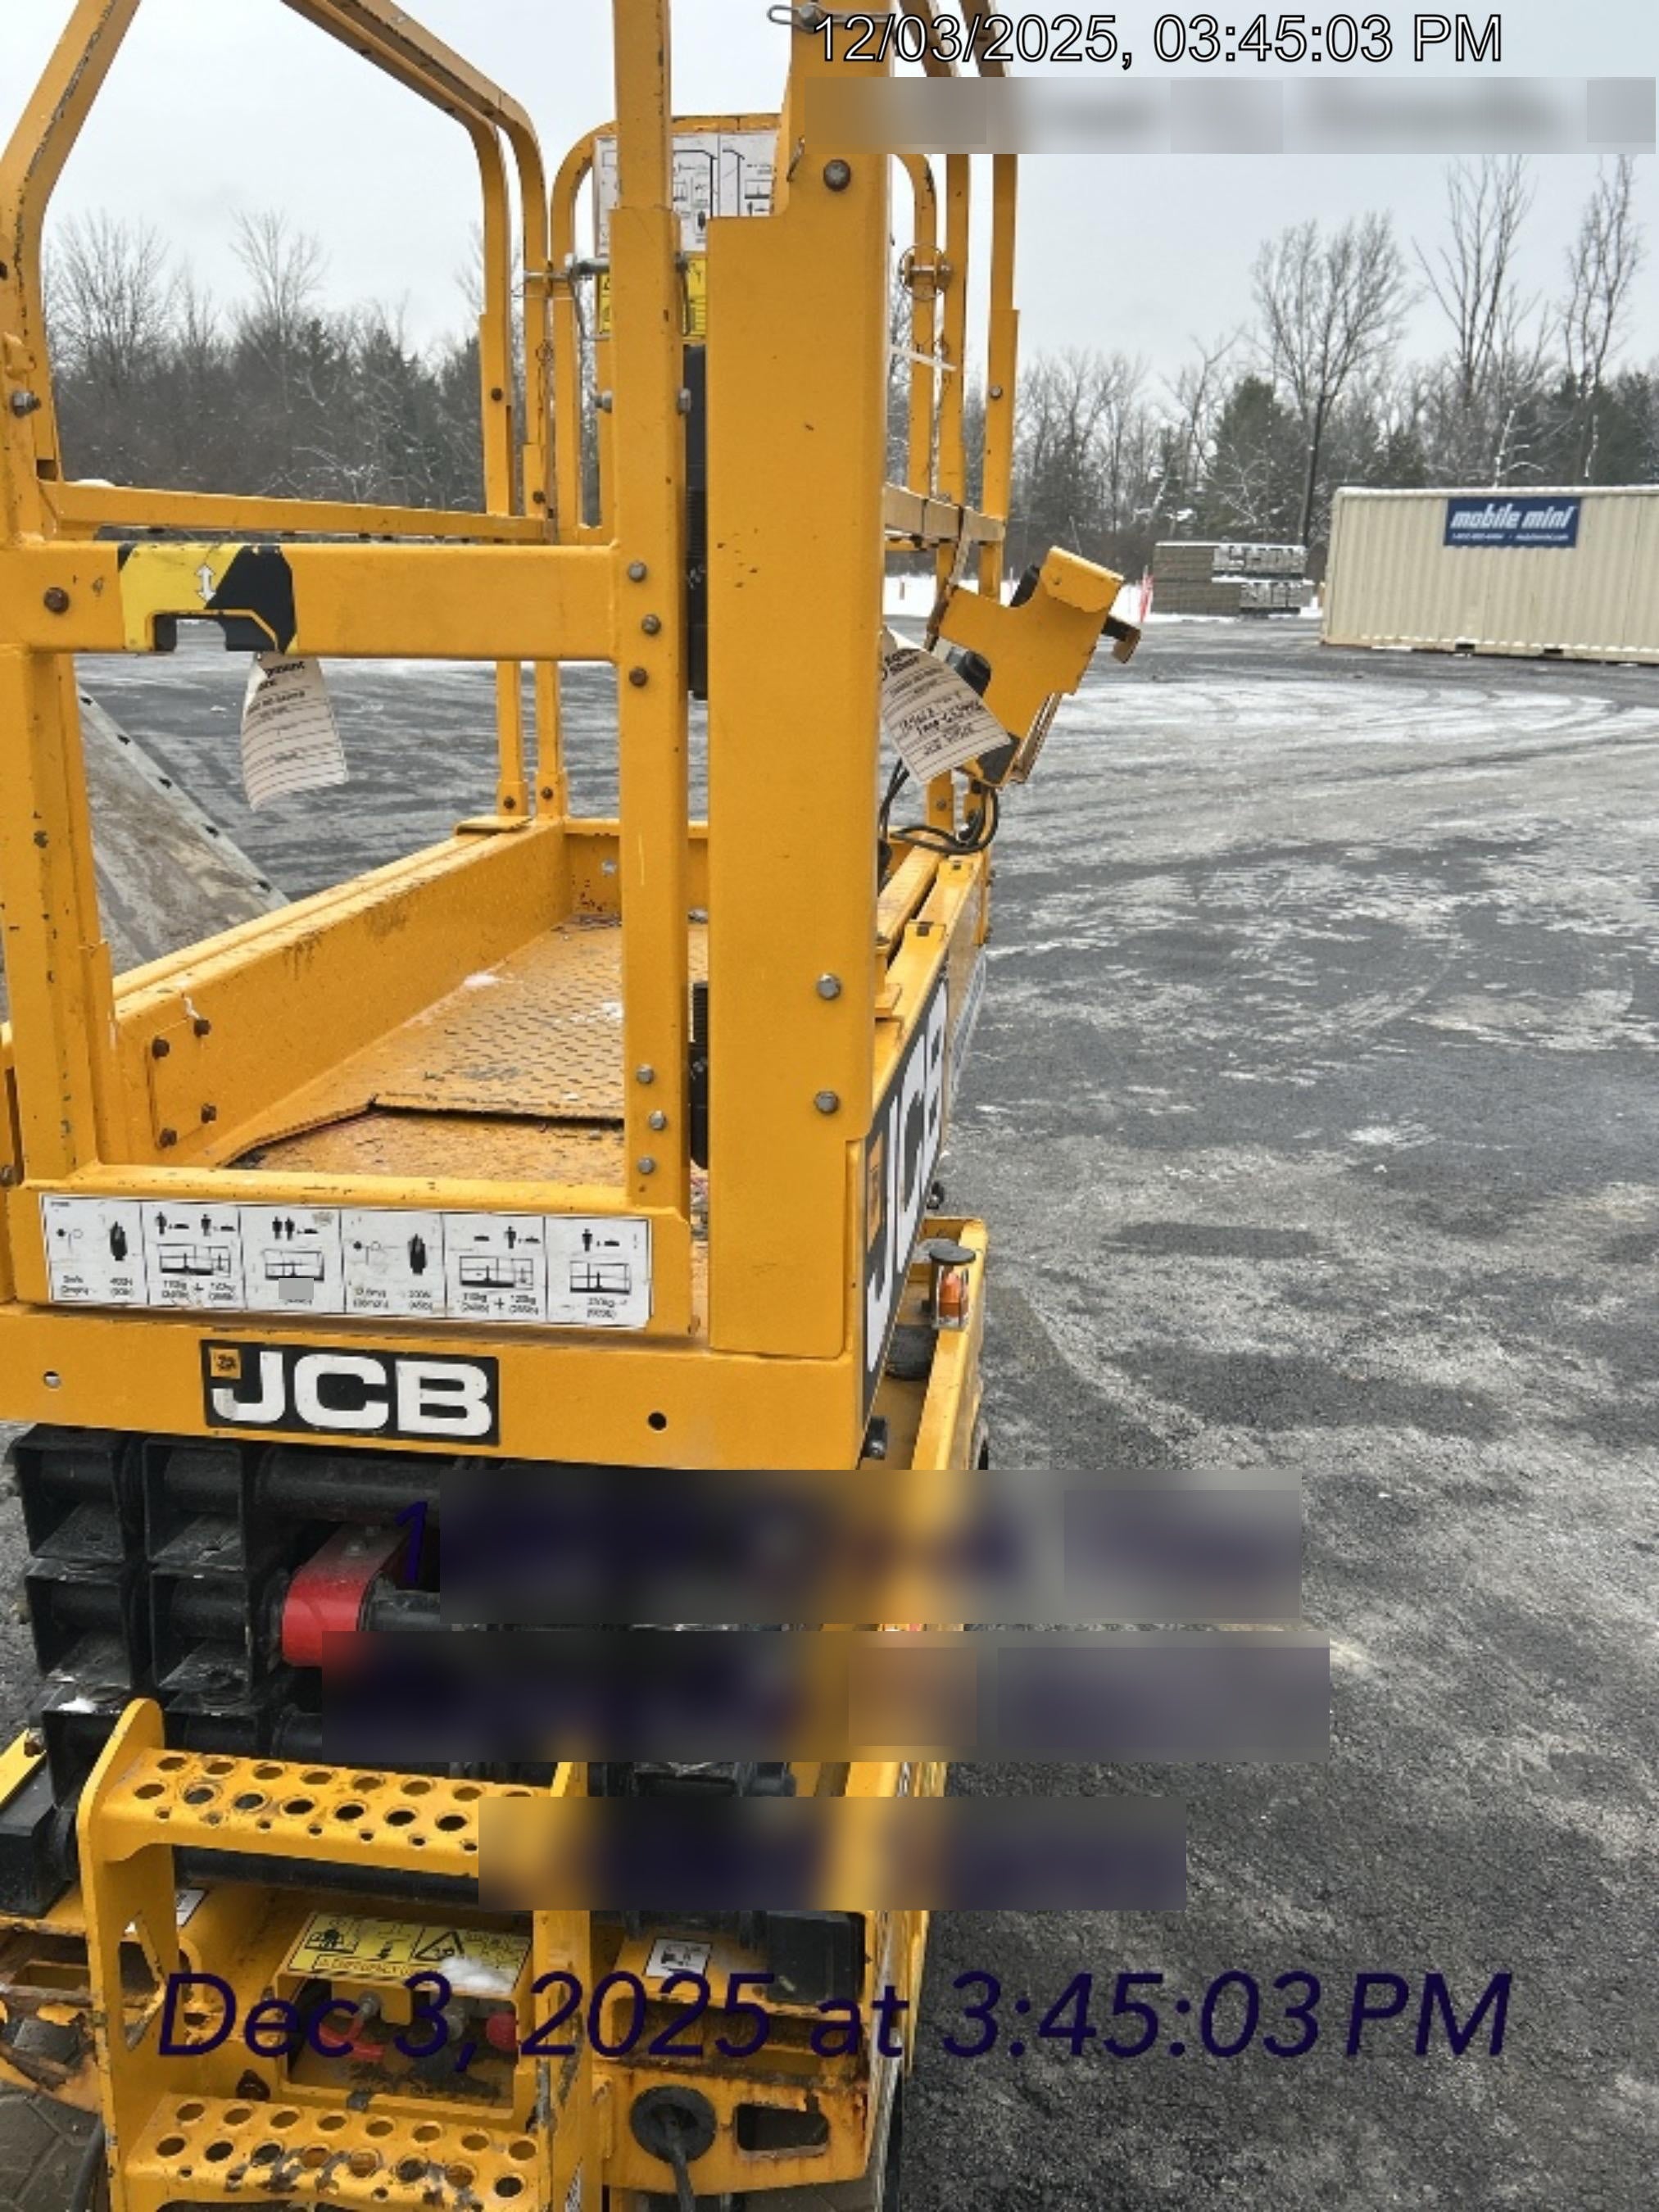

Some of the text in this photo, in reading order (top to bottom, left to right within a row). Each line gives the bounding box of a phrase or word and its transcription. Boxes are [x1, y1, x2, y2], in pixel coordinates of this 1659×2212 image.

[1450, 503, 1575, 529] mobile mini
[211, 1351, 492, 1436] JCB
